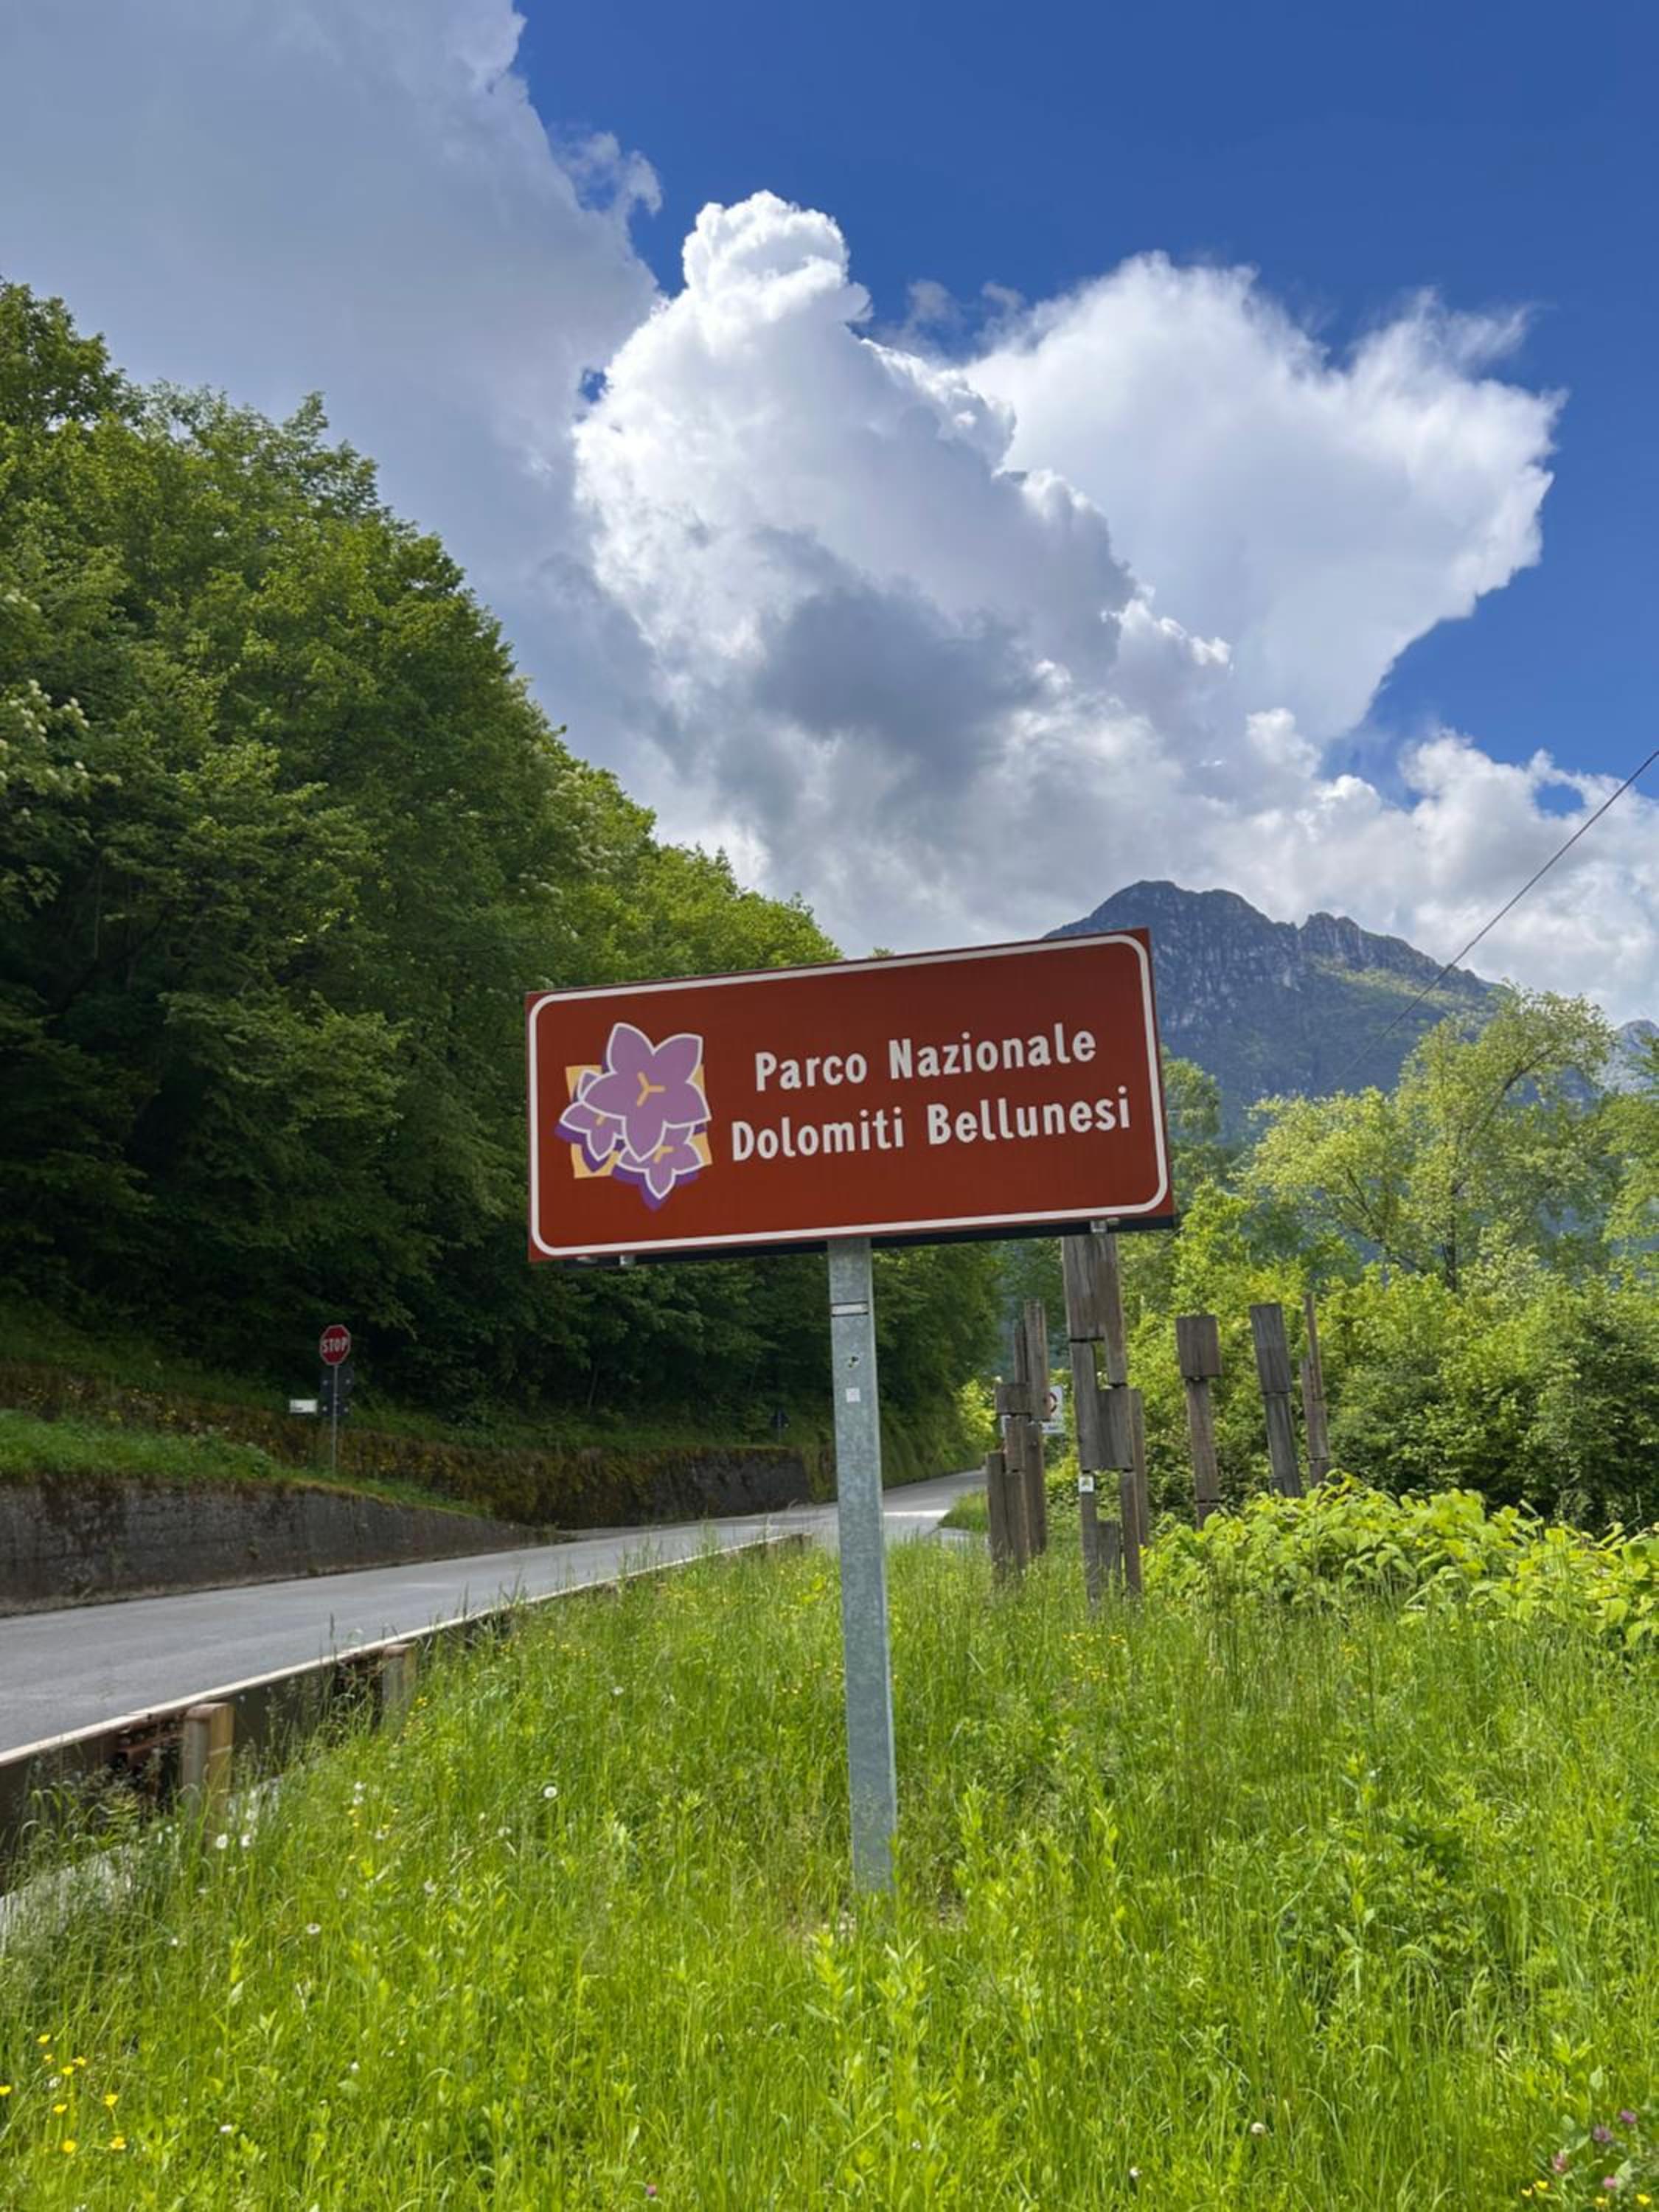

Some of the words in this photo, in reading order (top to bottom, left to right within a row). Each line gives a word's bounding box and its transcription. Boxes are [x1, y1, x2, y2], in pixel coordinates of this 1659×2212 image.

[755, 1051, 868, 1092] Parco
[888, 1023, 1096, 1079] Nazionale
[731, 1106, 904, 1161] Dolomiti
[927, 1085, 1130, 1145] Bellunesi
[322, 1338, 349, 1353] STOP
